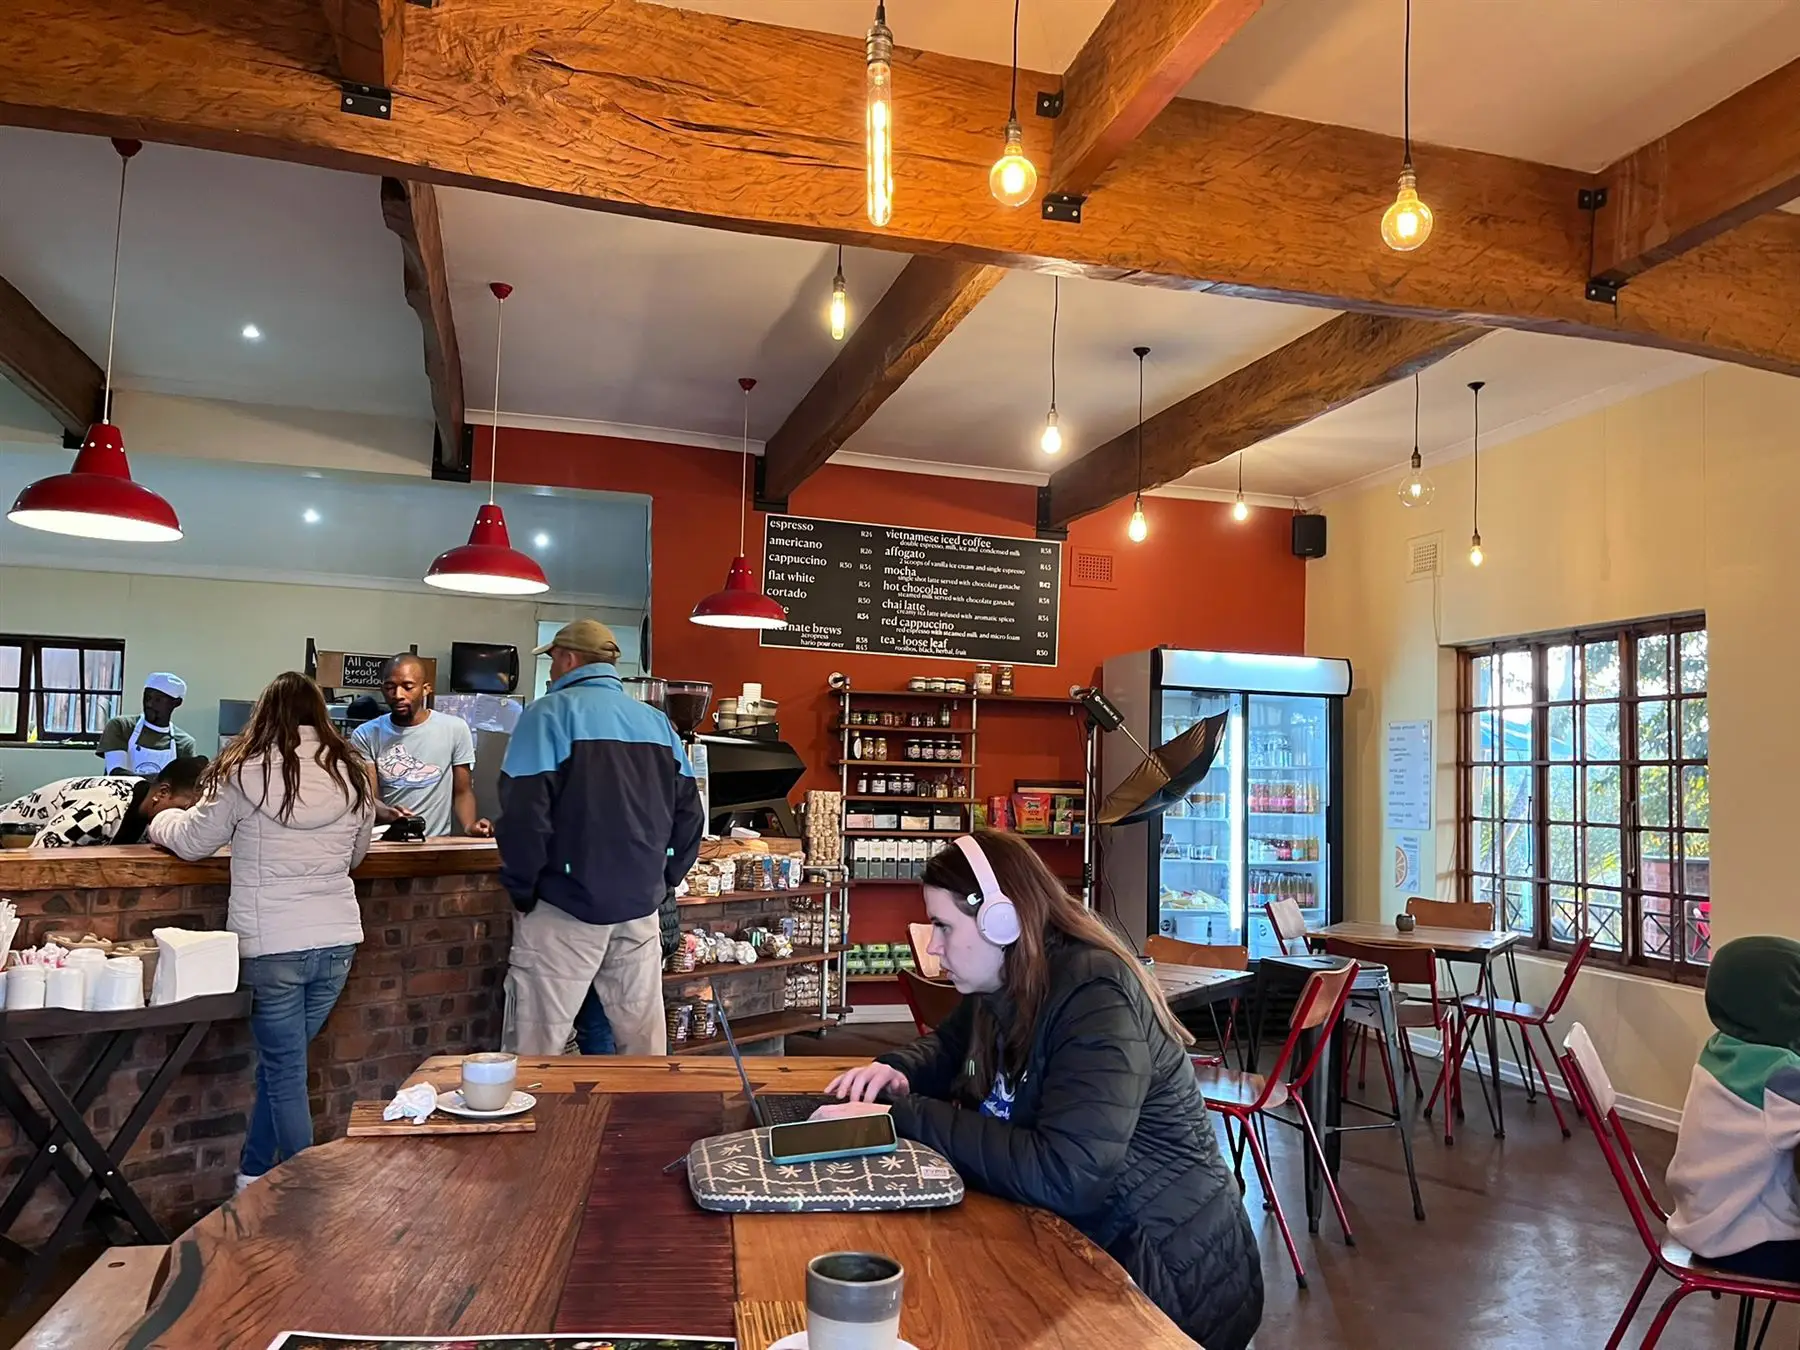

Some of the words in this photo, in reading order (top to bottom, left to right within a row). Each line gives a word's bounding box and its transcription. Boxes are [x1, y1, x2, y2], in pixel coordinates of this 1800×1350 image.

[770, 520, 814, 532] espresso
[769, 537, 822, 549] americano
[886, 529, 939, 542] vietnamese
[941, 534, 960, 545] iced
[962, 537, 991, 548] coffee
[885, 546, 925, 559] affogato
[769, 553, 827, 566] cappuccino
[768, 570, 785, 580] flat
[788, 572, 816, 583] white
[884, 566, 916, 576] mocha
[766, 588, 807, 599] cortado
[884, 580, 899, 591] hot
[902, 582, 948, 596] chocolate
[882, 599, 902, 609] chai
[904, 600, 925, 611] latte
[766, 623, 810, 632] ernate
[813, 623, 842, 635] brews
[881, 616, 898, 626] red
[900, 619, 954, 630] cappuccino
[881, 636, 895, 645] tea
[903, 635, 928, 646] loose
[930, 638, 949, 648] leaf
[348, 657, 361, 666] All
[345, 667, 377, 676] breads
